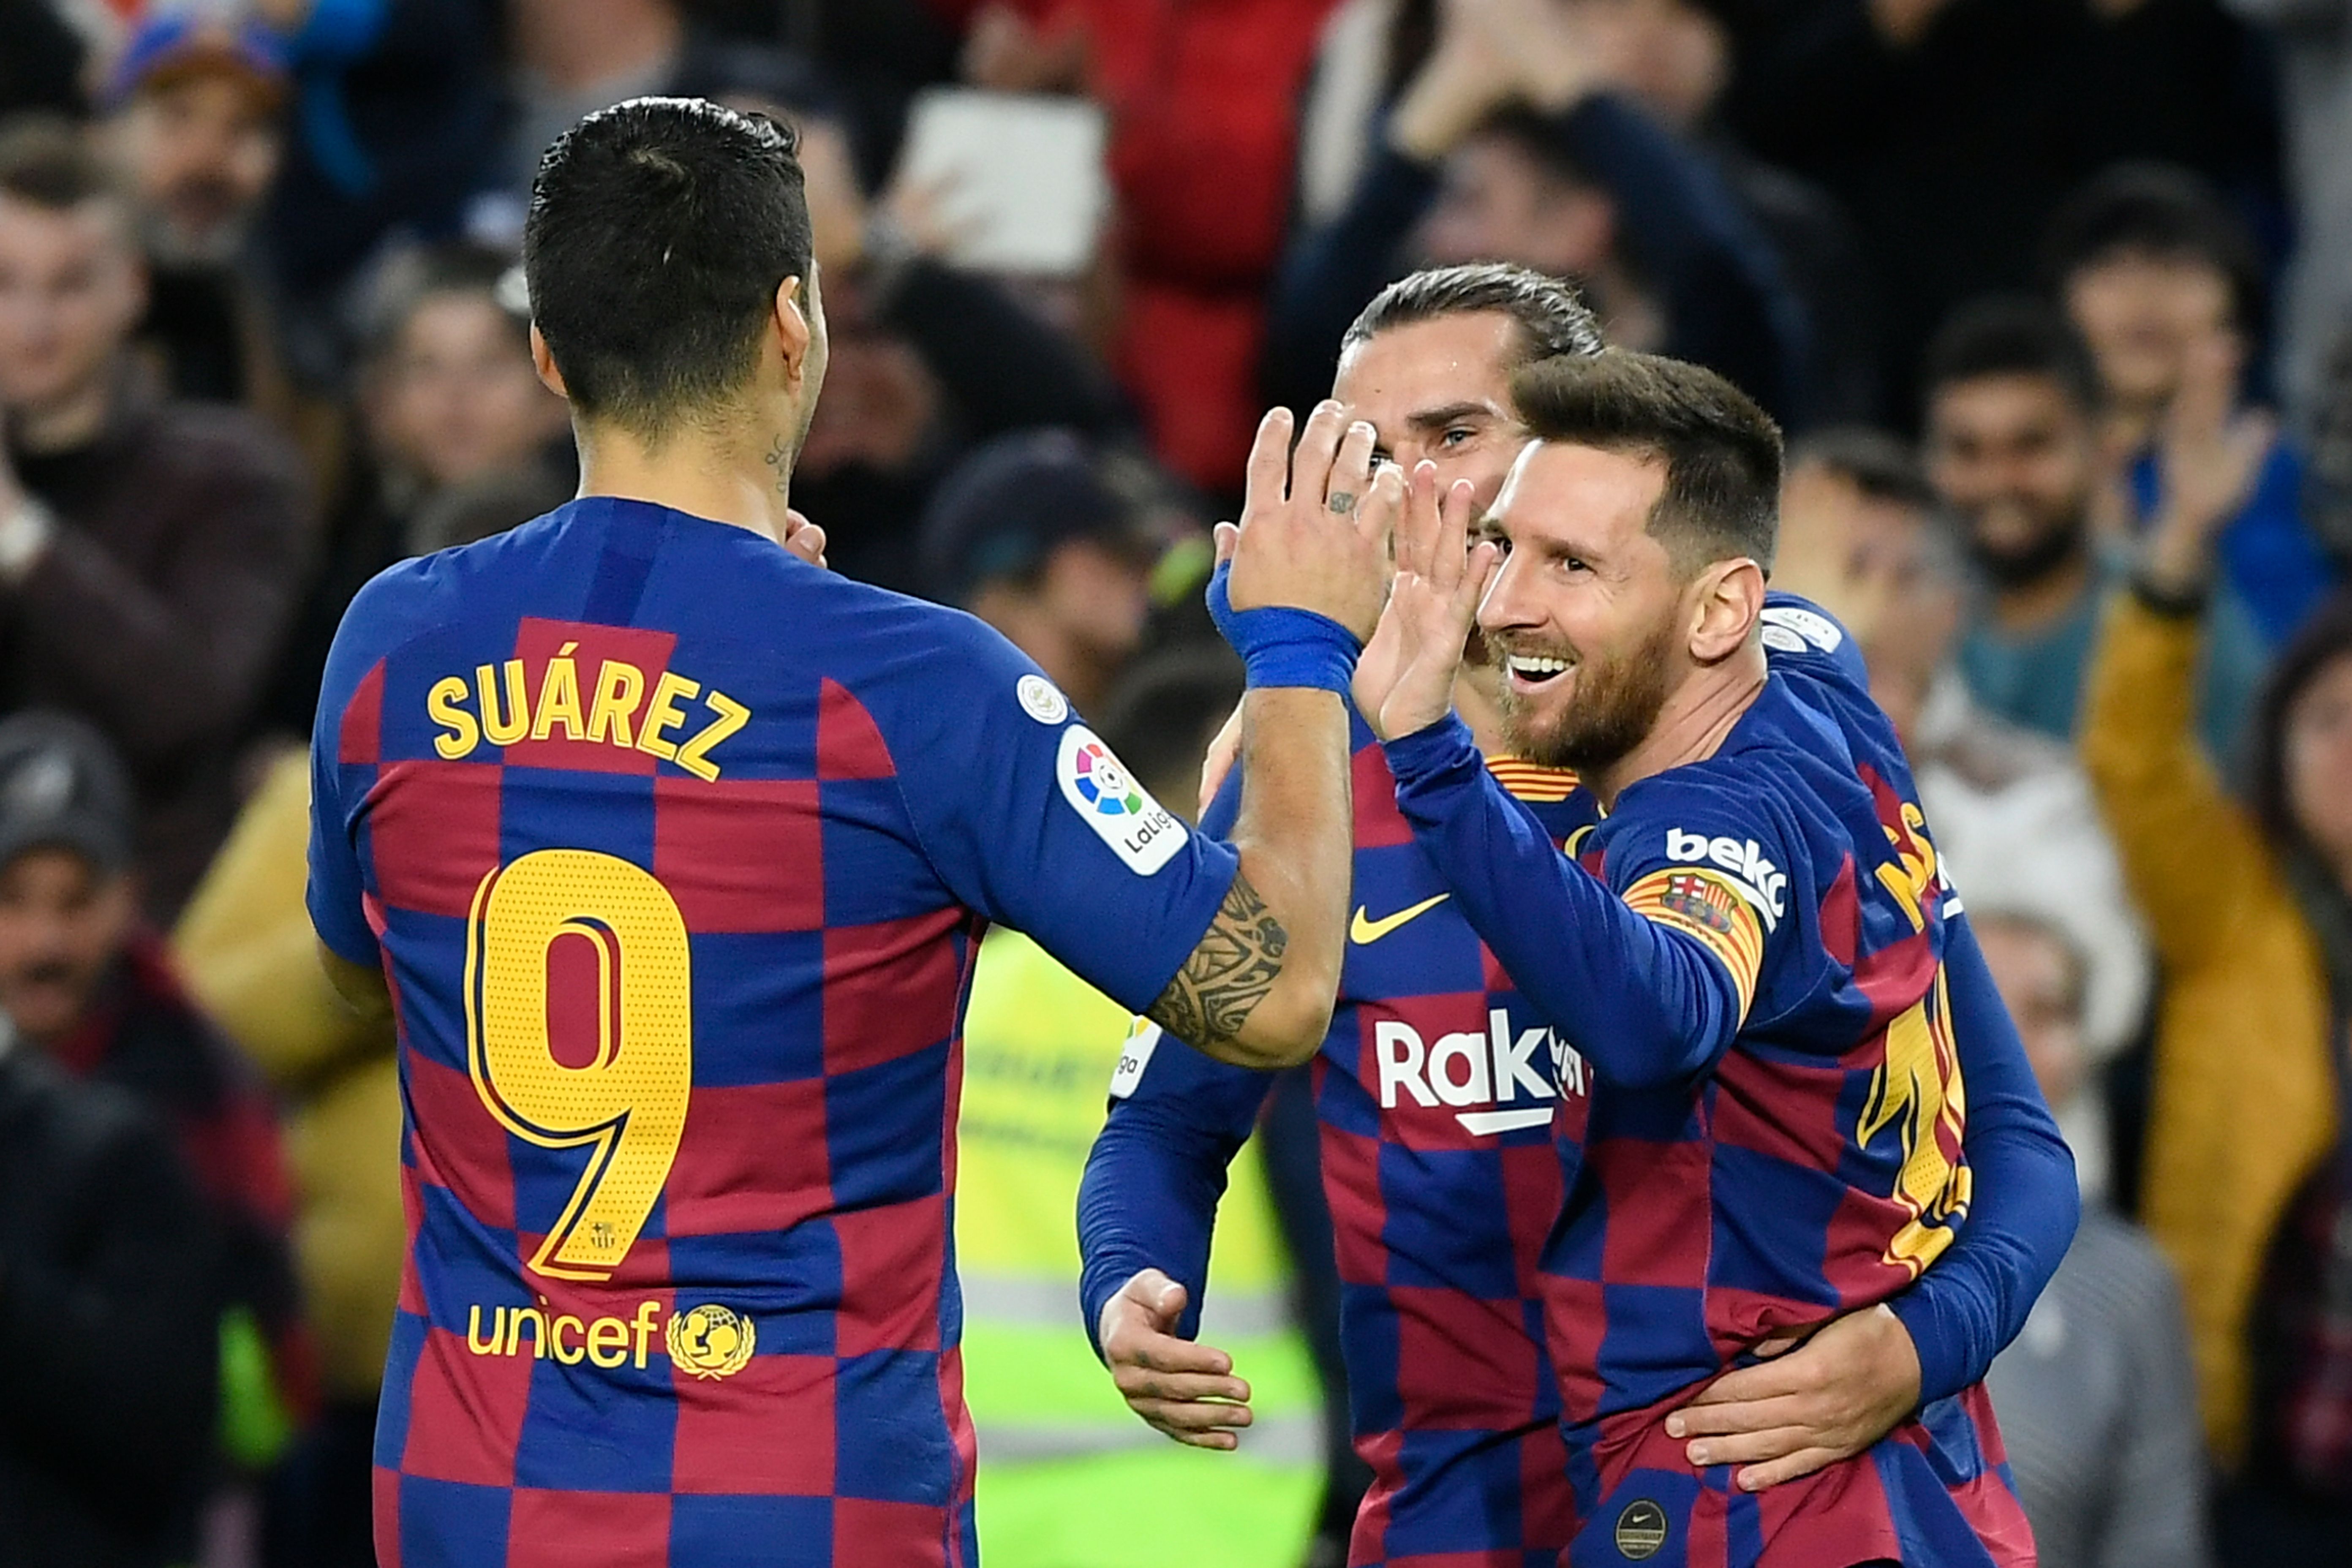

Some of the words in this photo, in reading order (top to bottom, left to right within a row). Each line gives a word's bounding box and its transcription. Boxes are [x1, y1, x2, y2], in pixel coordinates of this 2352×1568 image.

[427, 642, 751, 783] SUÁREZ
[1124, 808, 1173, 854] LaLig
[463, 848, 692, 1281] 9
[468, 1295, 661, 1369] unicef
